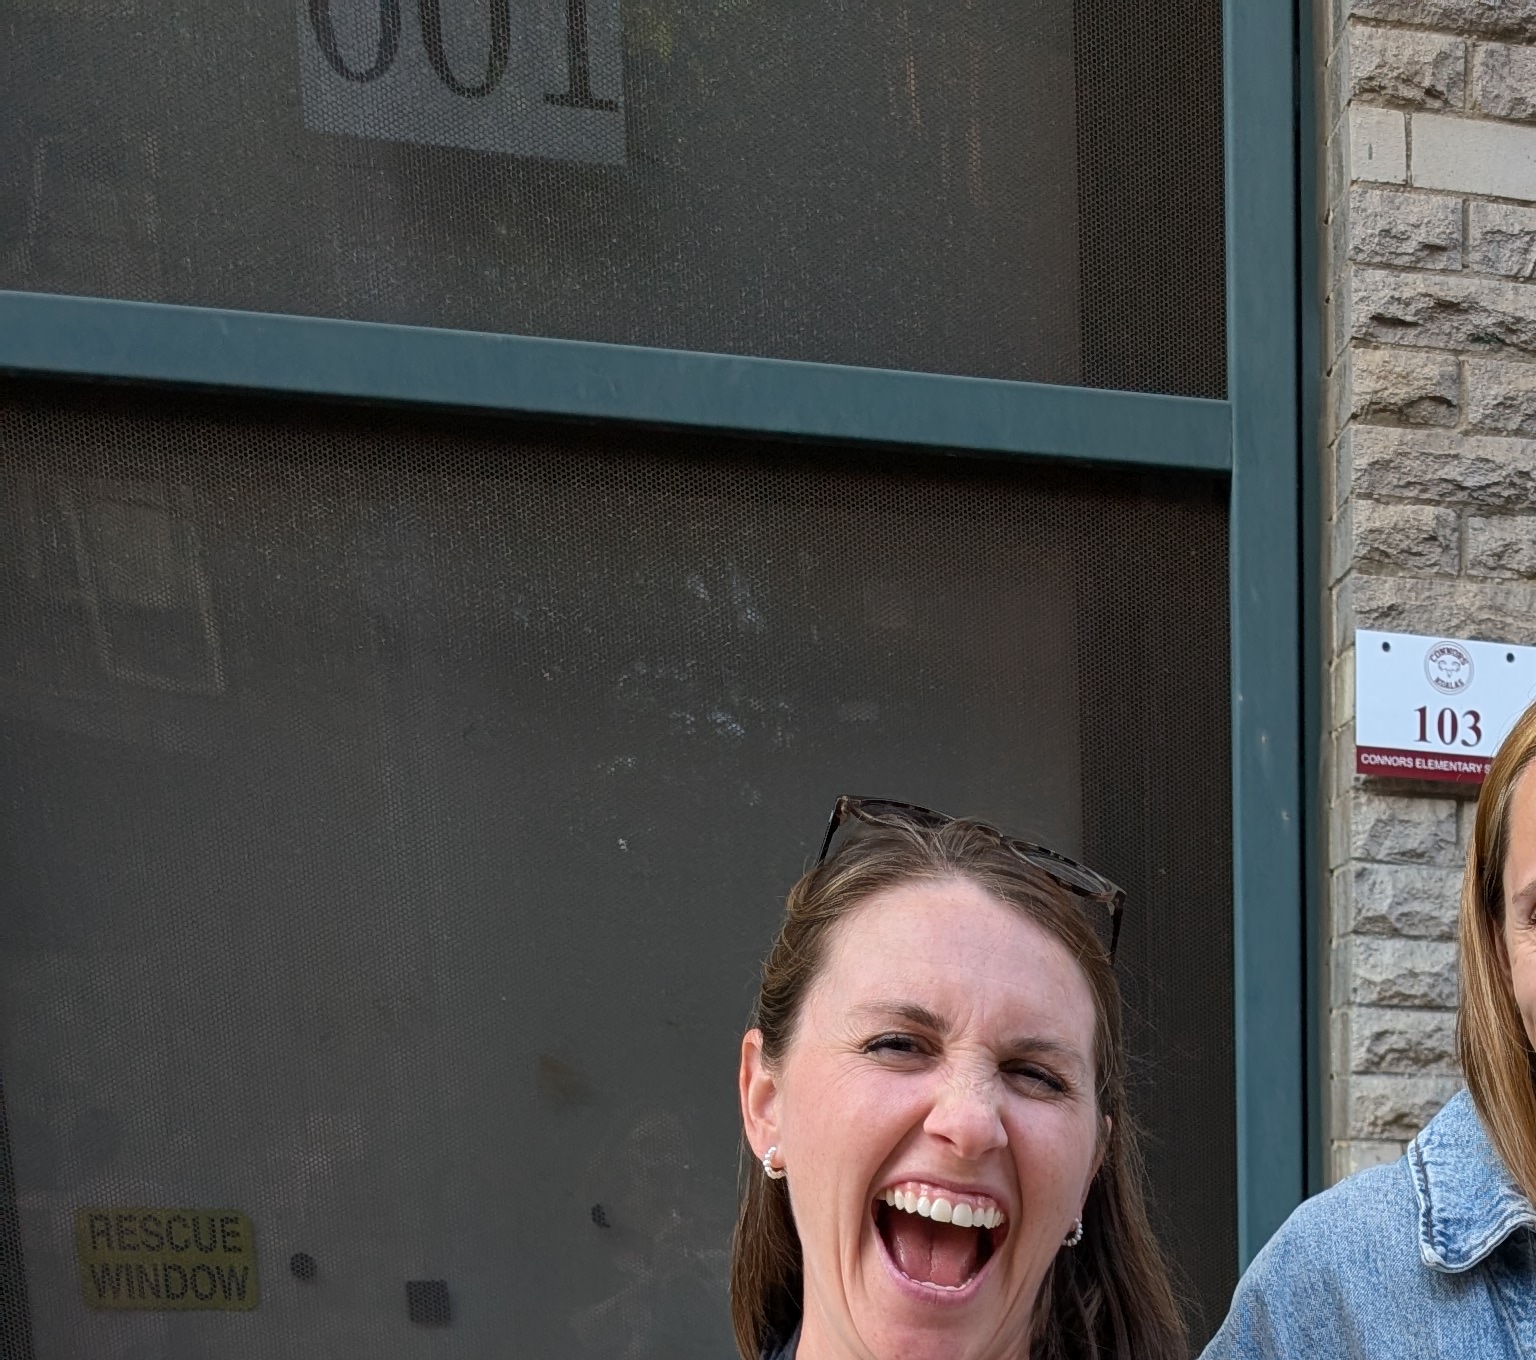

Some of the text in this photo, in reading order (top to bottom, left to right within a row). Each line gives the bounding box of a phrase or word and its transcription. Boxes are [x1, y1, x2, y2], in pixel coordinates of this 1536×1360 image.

[1429, 647, 1469, 666] CONNORS
[1413, 705, 1483, 748] 103
[1360, 753, 1414, 769] CONNORS
[1415, 758, 1483, 774] ELEMENTARY
[88, 1213, 243, 1253] RESCUE
[89, 1262, 250, 1301] WINDOW
